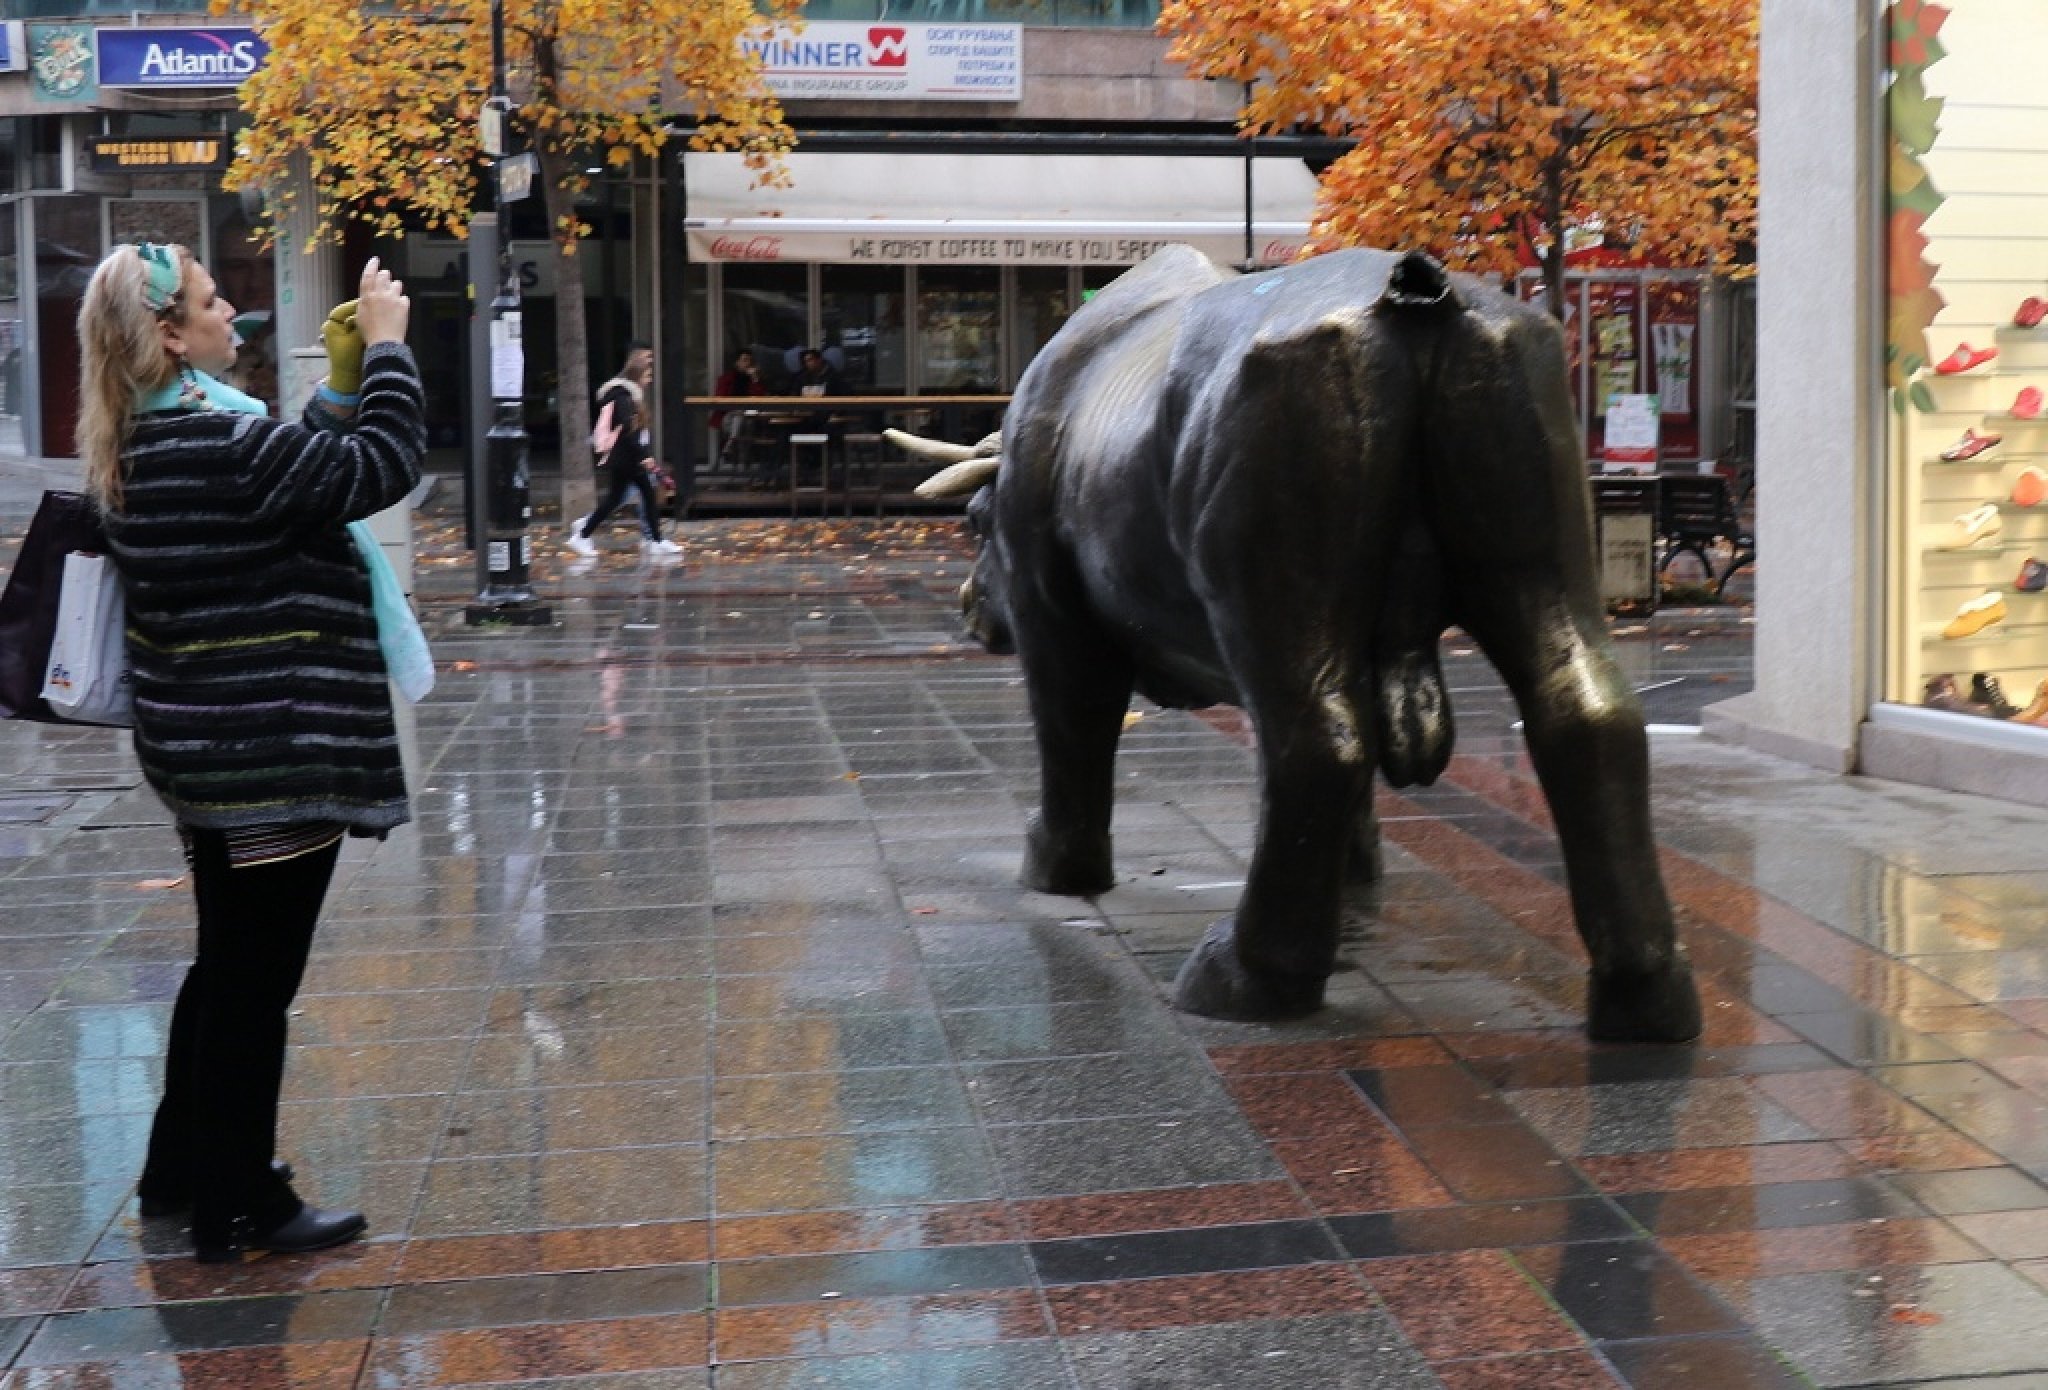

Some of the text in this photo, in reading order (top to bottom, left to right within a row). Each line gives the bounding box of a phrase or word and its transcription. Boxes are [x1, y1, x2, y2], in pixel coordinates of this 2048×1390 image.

[139, 41, 257, 75] AtlantiS
[742, 41, 862, 67] WINNER
[793, 80, 862, 90] INSURANCE
[866, 80, 908, 91] GROUP
[96, 143, 169, 154] WESTERN
[851, 239, 874, 258] WE
[881, 240, 931, 258] ROAST
[939, 240, 997, 258] COFFEE
[1004, 240, 1026, 258] TO
[1032, 240, 1073, 259] MAKE
[1080, 240, 1112, 260] YOU
